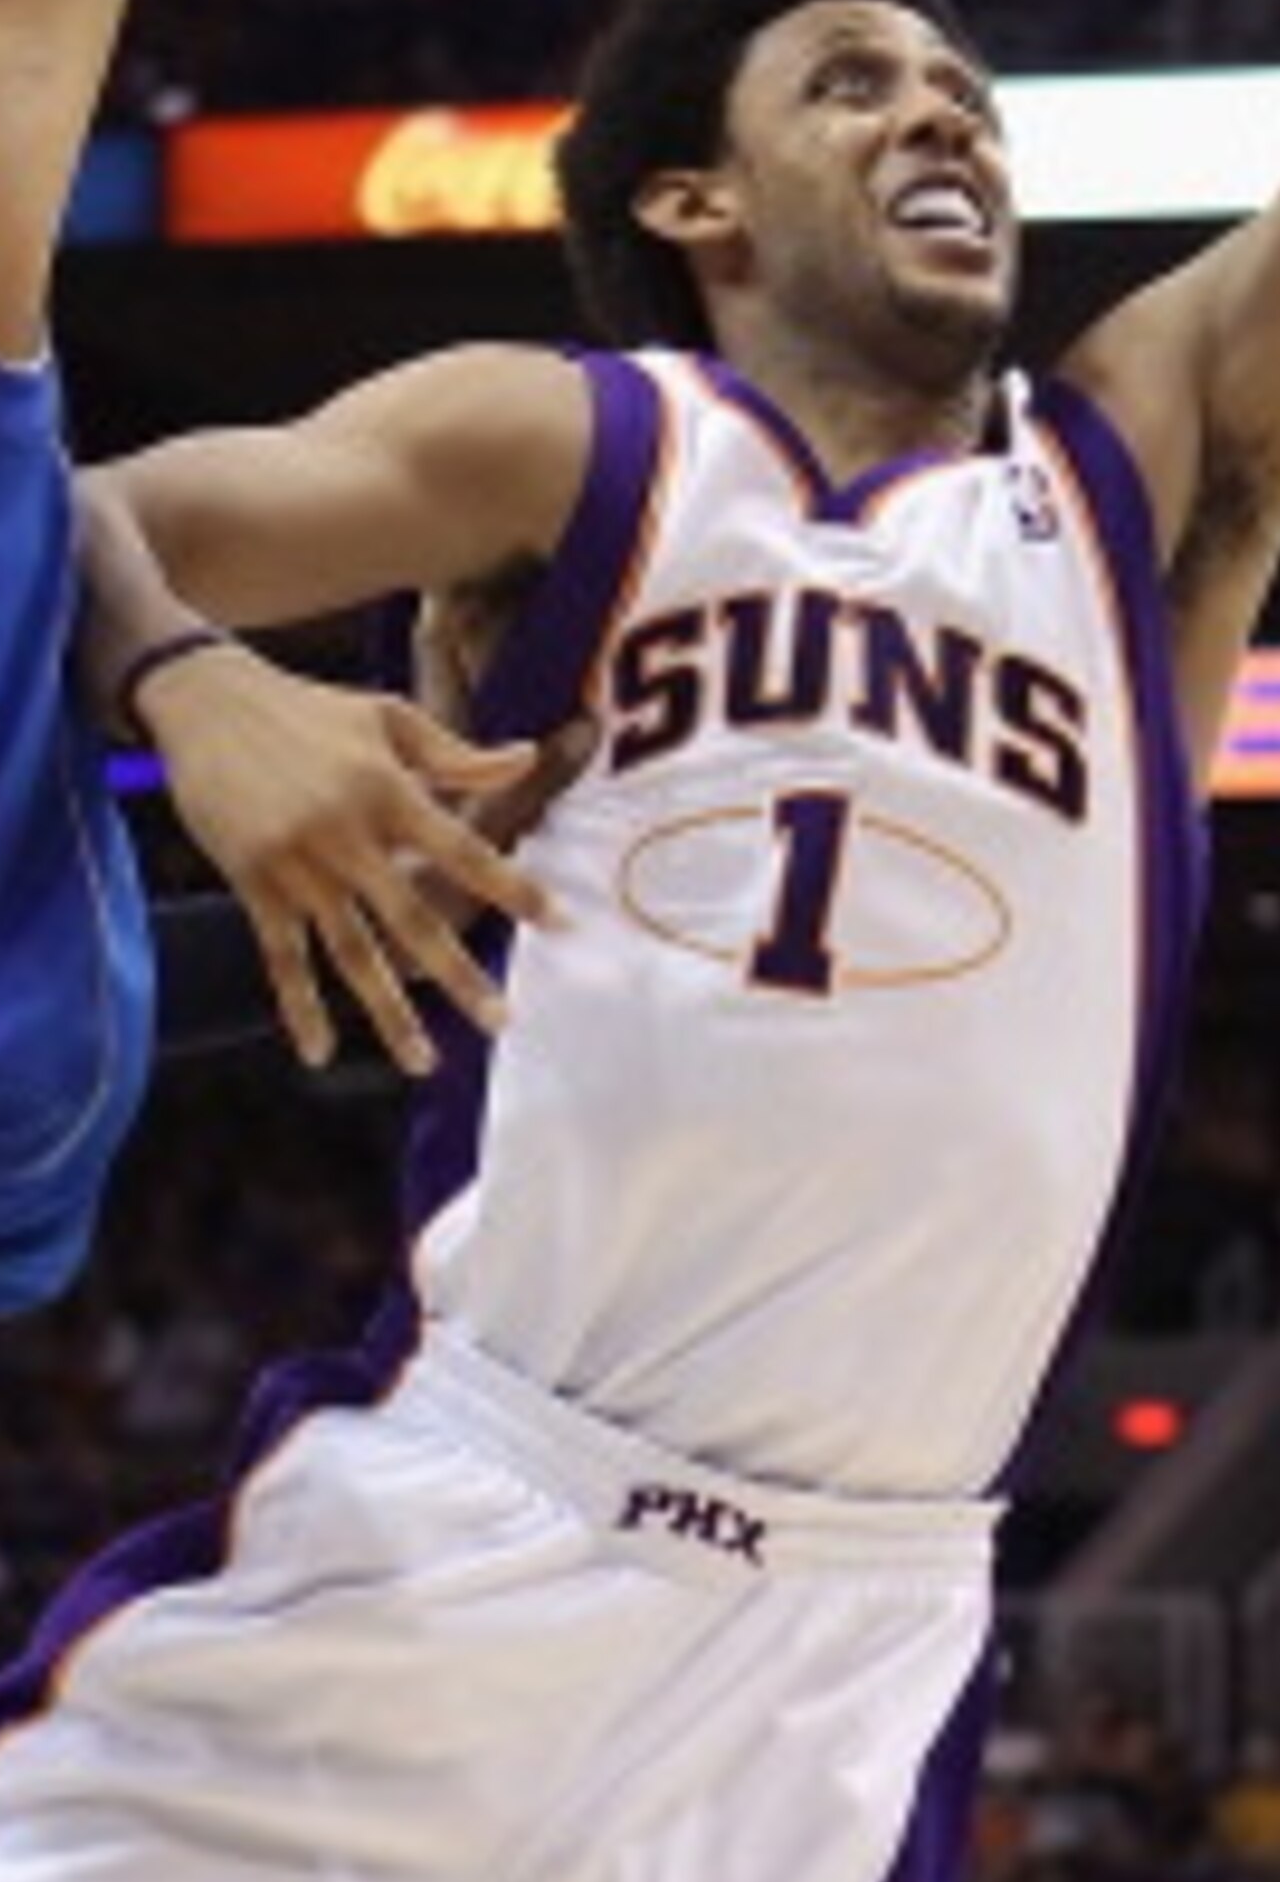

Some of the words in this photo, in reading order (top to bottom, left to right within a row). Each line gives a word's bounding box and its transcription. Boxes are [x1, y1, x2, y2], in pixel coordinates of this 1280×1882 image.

[608, 584, 1090, 828] SUNS
[745, 786, 852, 998] 1
[616, 1482, 768, 1569] PHX
